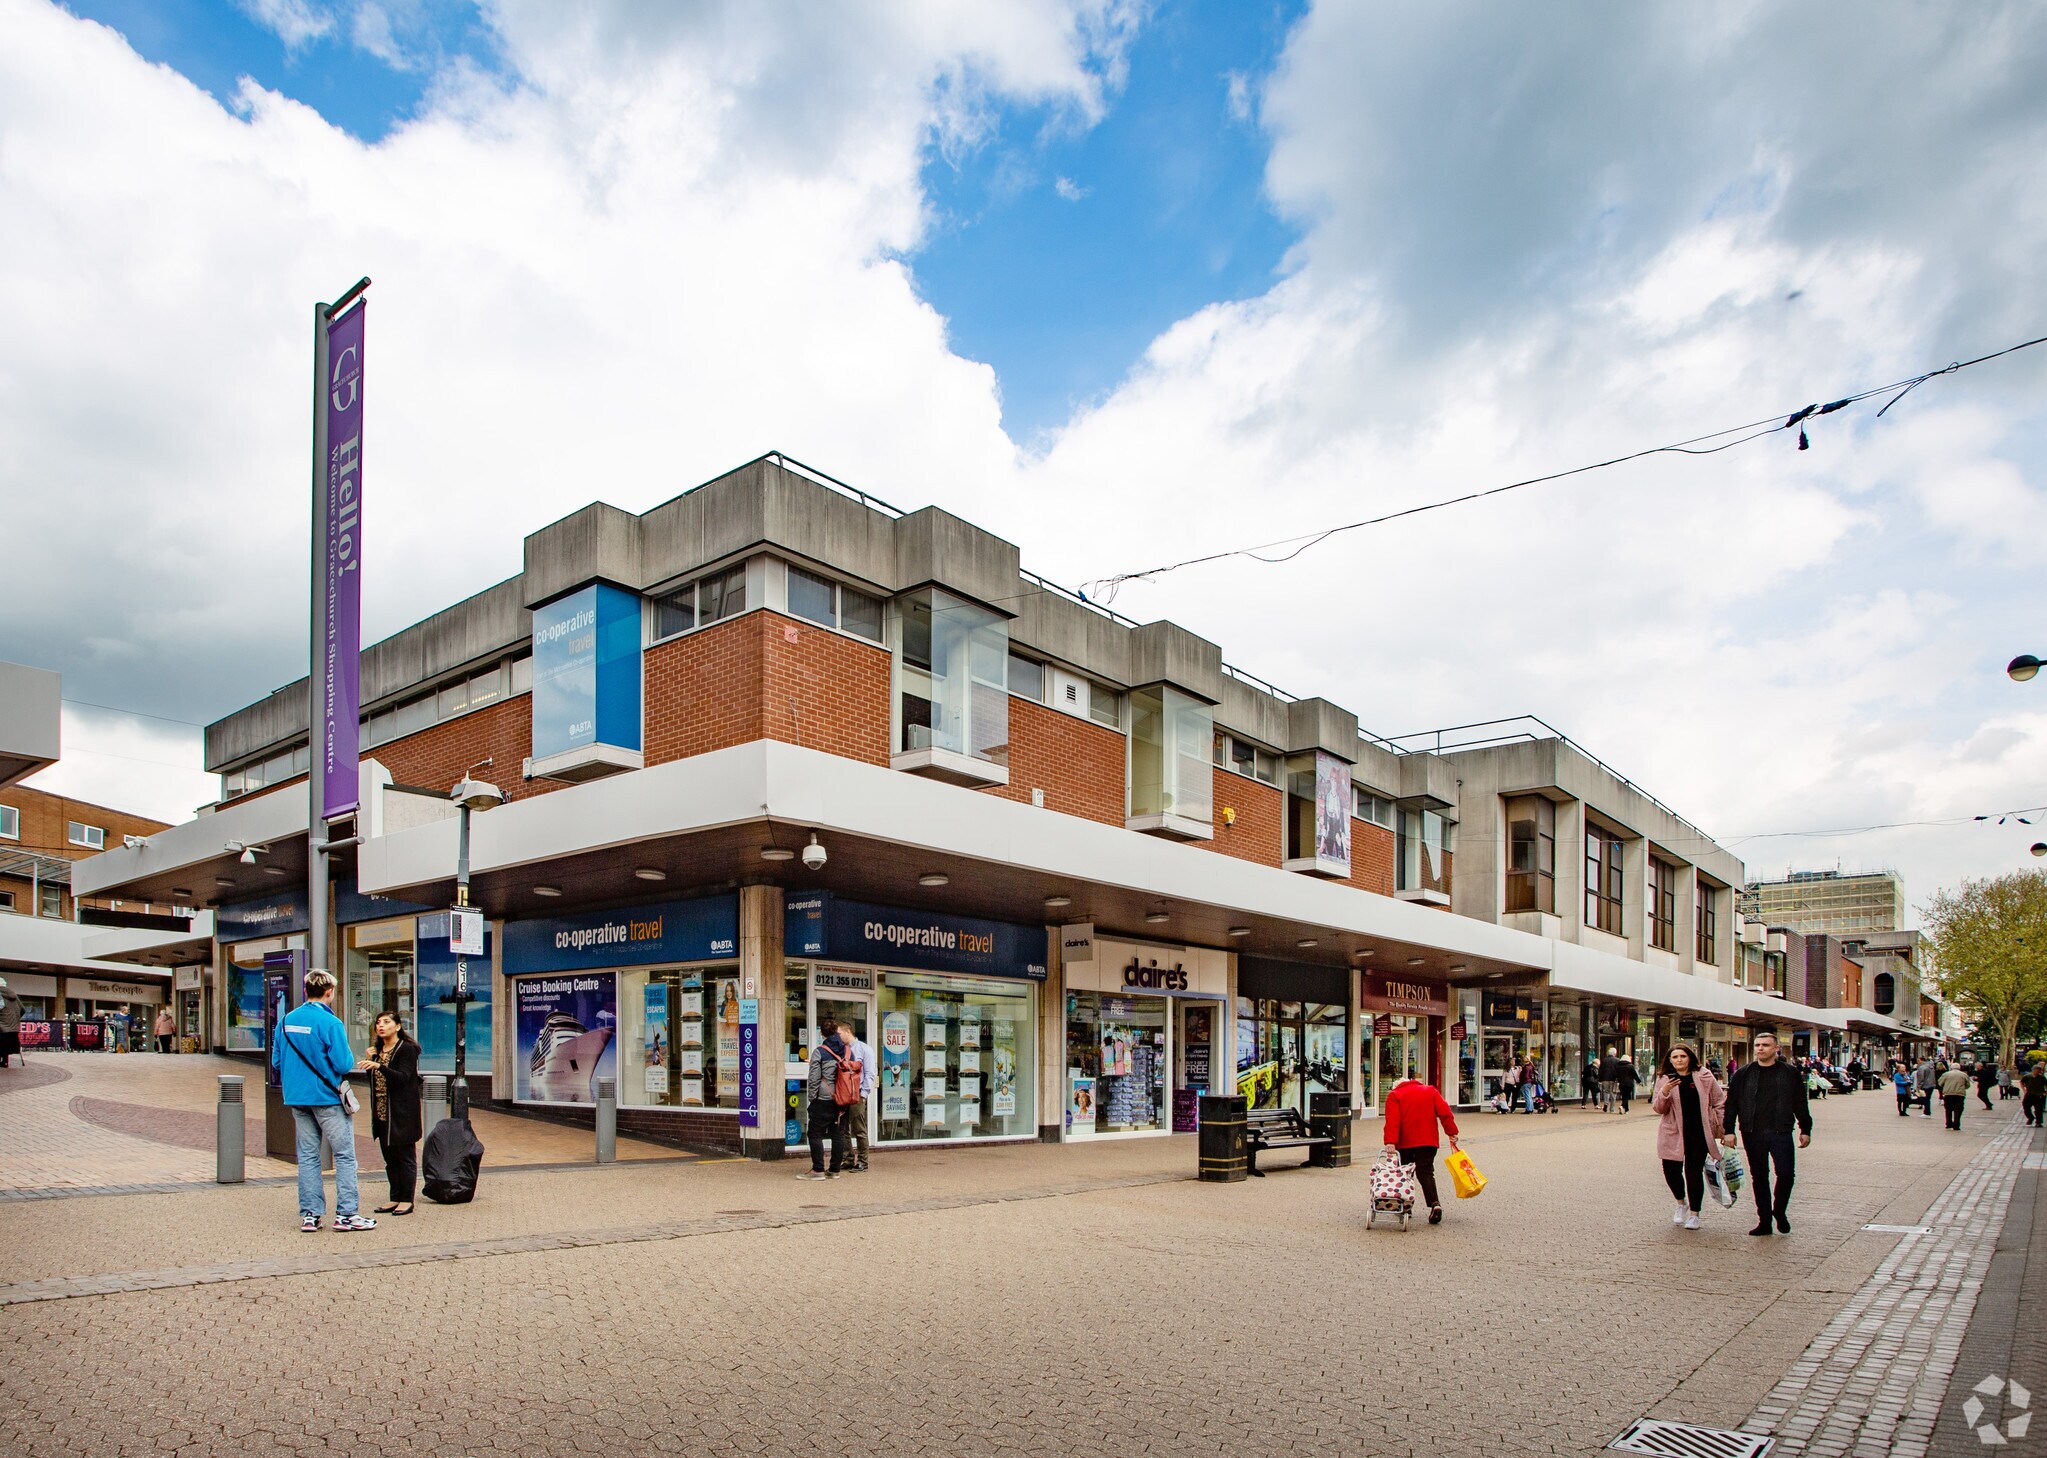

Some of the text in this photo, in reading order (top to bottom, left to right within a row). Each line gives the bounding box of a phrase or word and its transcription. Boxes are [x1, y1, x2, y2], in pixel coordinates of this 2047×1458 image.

[337, 431, 359, 577] Hello!
[326, 445, 339, 774] Welcome to Gracechurch Shopping Centre
[536, 610, 595, 645] co-operative
[568, 628, 594, 655] travel
[574, 720, 593, 734] ABTA
[788, 900, 822, 910] co-operative
[807, 911, 822, 919] travel
[555, 915, 663, 951] co-operative travel
[864, 921, 993, 954] co-operative travel
[716, 940, 733, 949] ABTA
[1065, 938, 1089, 948] claire's
[1032, 965, 1046, 974] ABTA
[1123, 957, 1188, 991] claire's
[518, 977, 599, 994] Cruise Booking Centre
[816, 974, 869, 987] 0121 355 0713
[1385, 981, 1431, 1001] TIMPSON
[522, 995, 542, 1003] Competitive
[532, 1004, 552, 1012] knowledge
[646, 1005, 665, 1013] ESCAPES
[1110, 1006, 1125, 1015] FREE
[19, 1021, 51, 1033] ED'S
[76, 1024, 99, 1036] TED'S
[886, 1035, 906, 1045] SALE
[1185, 1064, 1208, 1074] FREE
[720, 1072, 739, 1081] TRUST
[886, 1103, 906, 1111] SAVINGS
